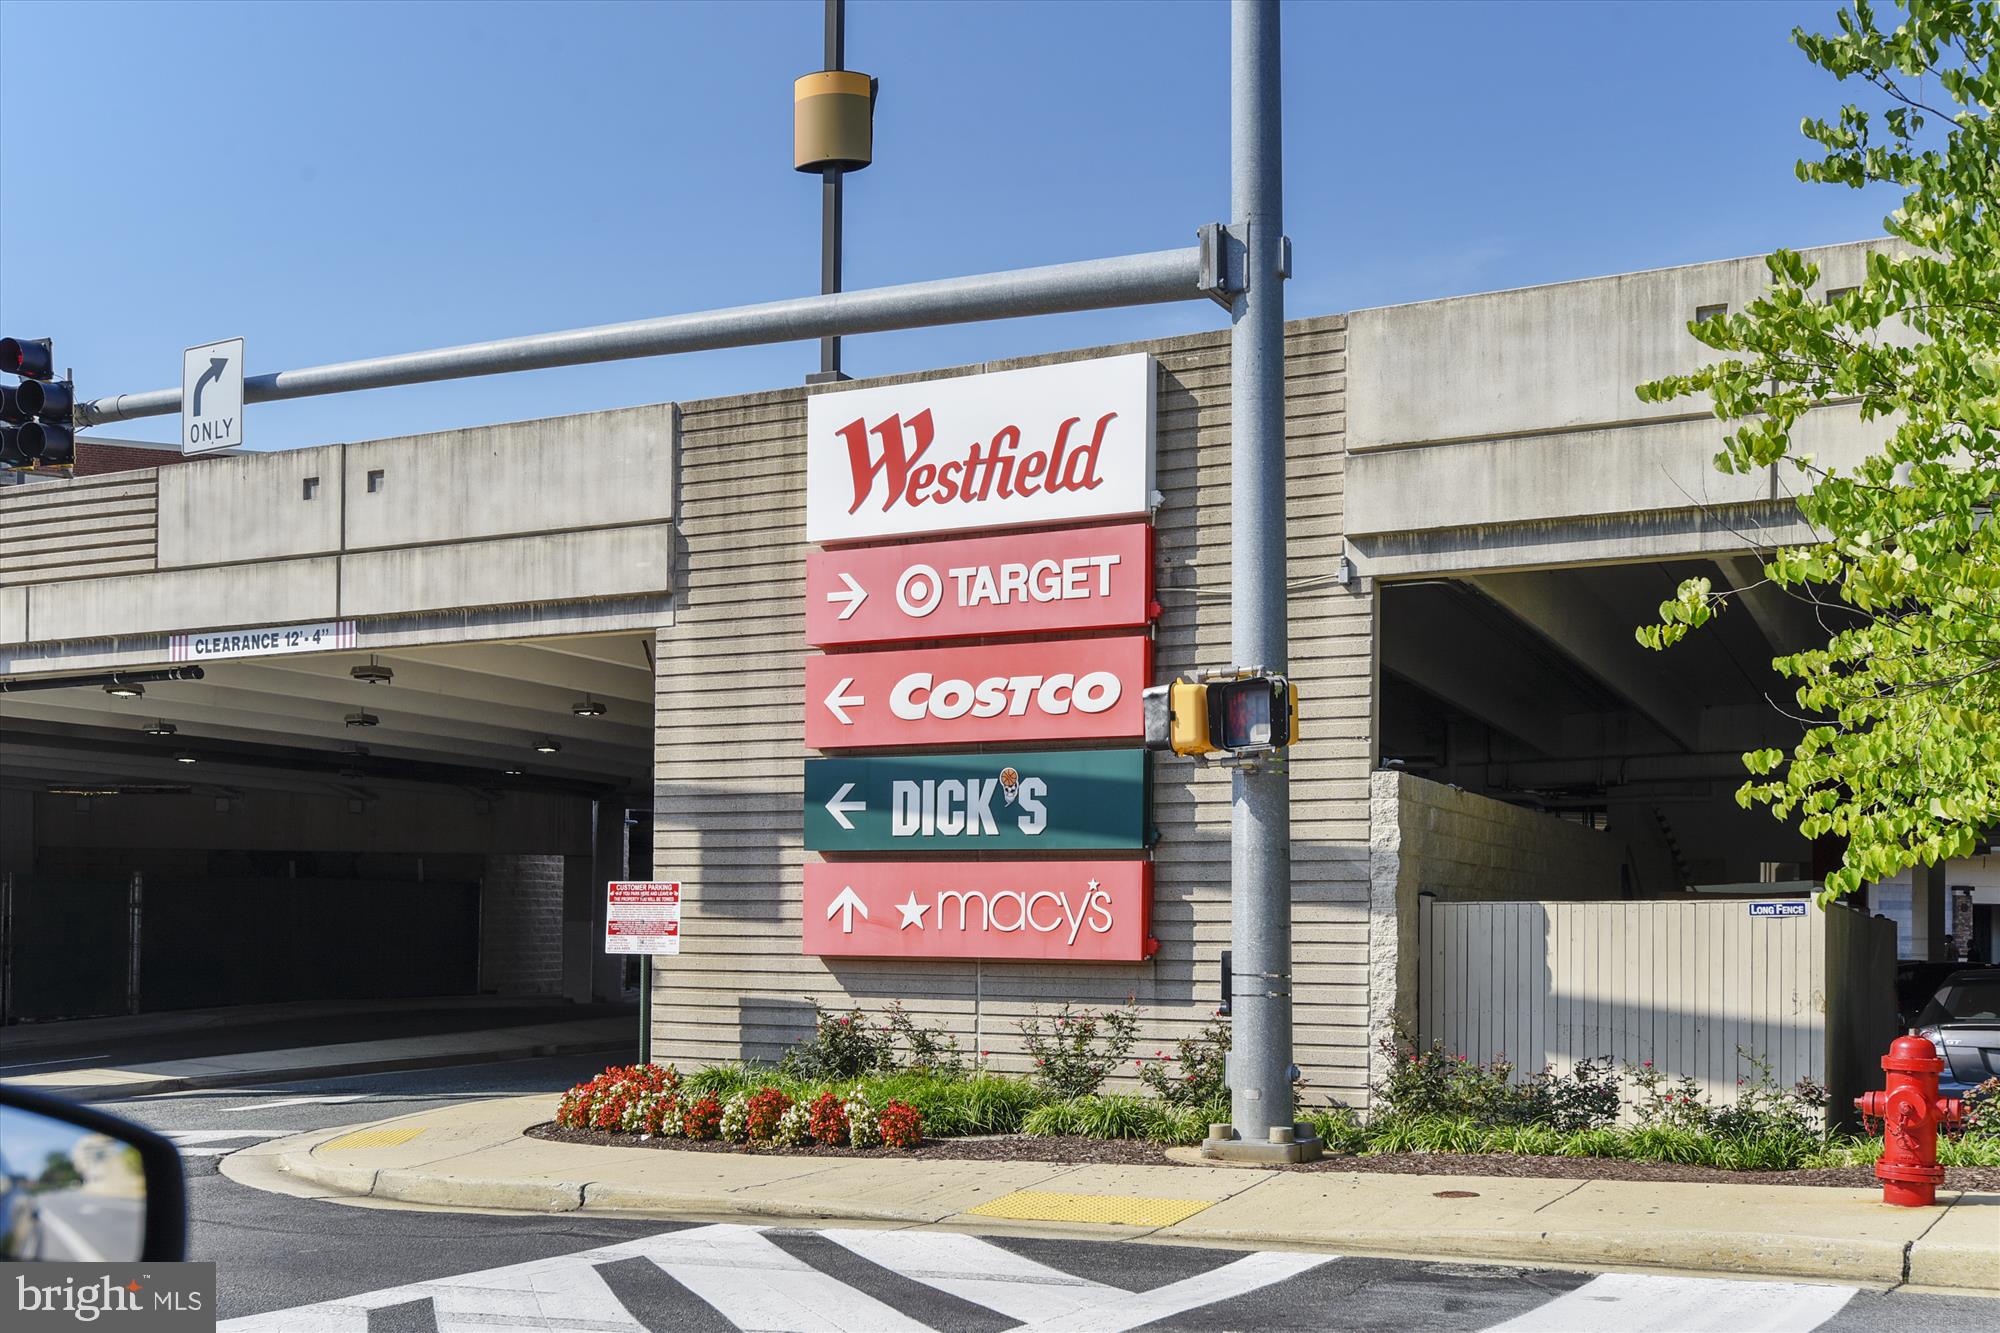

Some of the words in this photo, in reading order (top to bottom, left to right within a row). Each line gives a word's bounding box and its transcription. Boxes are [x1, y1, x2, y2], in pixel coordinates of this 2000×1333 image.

[190, 417, 233, 443] ONLY
[834, 407, 1118, 515] Westfield
[949, 554, 1121, 607] TARGET
[195, 633, 279, 654] CLEARANCE
[889, 671, 1122, 720] COSTCO
[892, 767, 1048, 837] DICK'S
[937, 877, 1113, 946] macy's
[1750, 904, 1774, 915] LONG
[1776, 903, 1804, 915] FENCE
